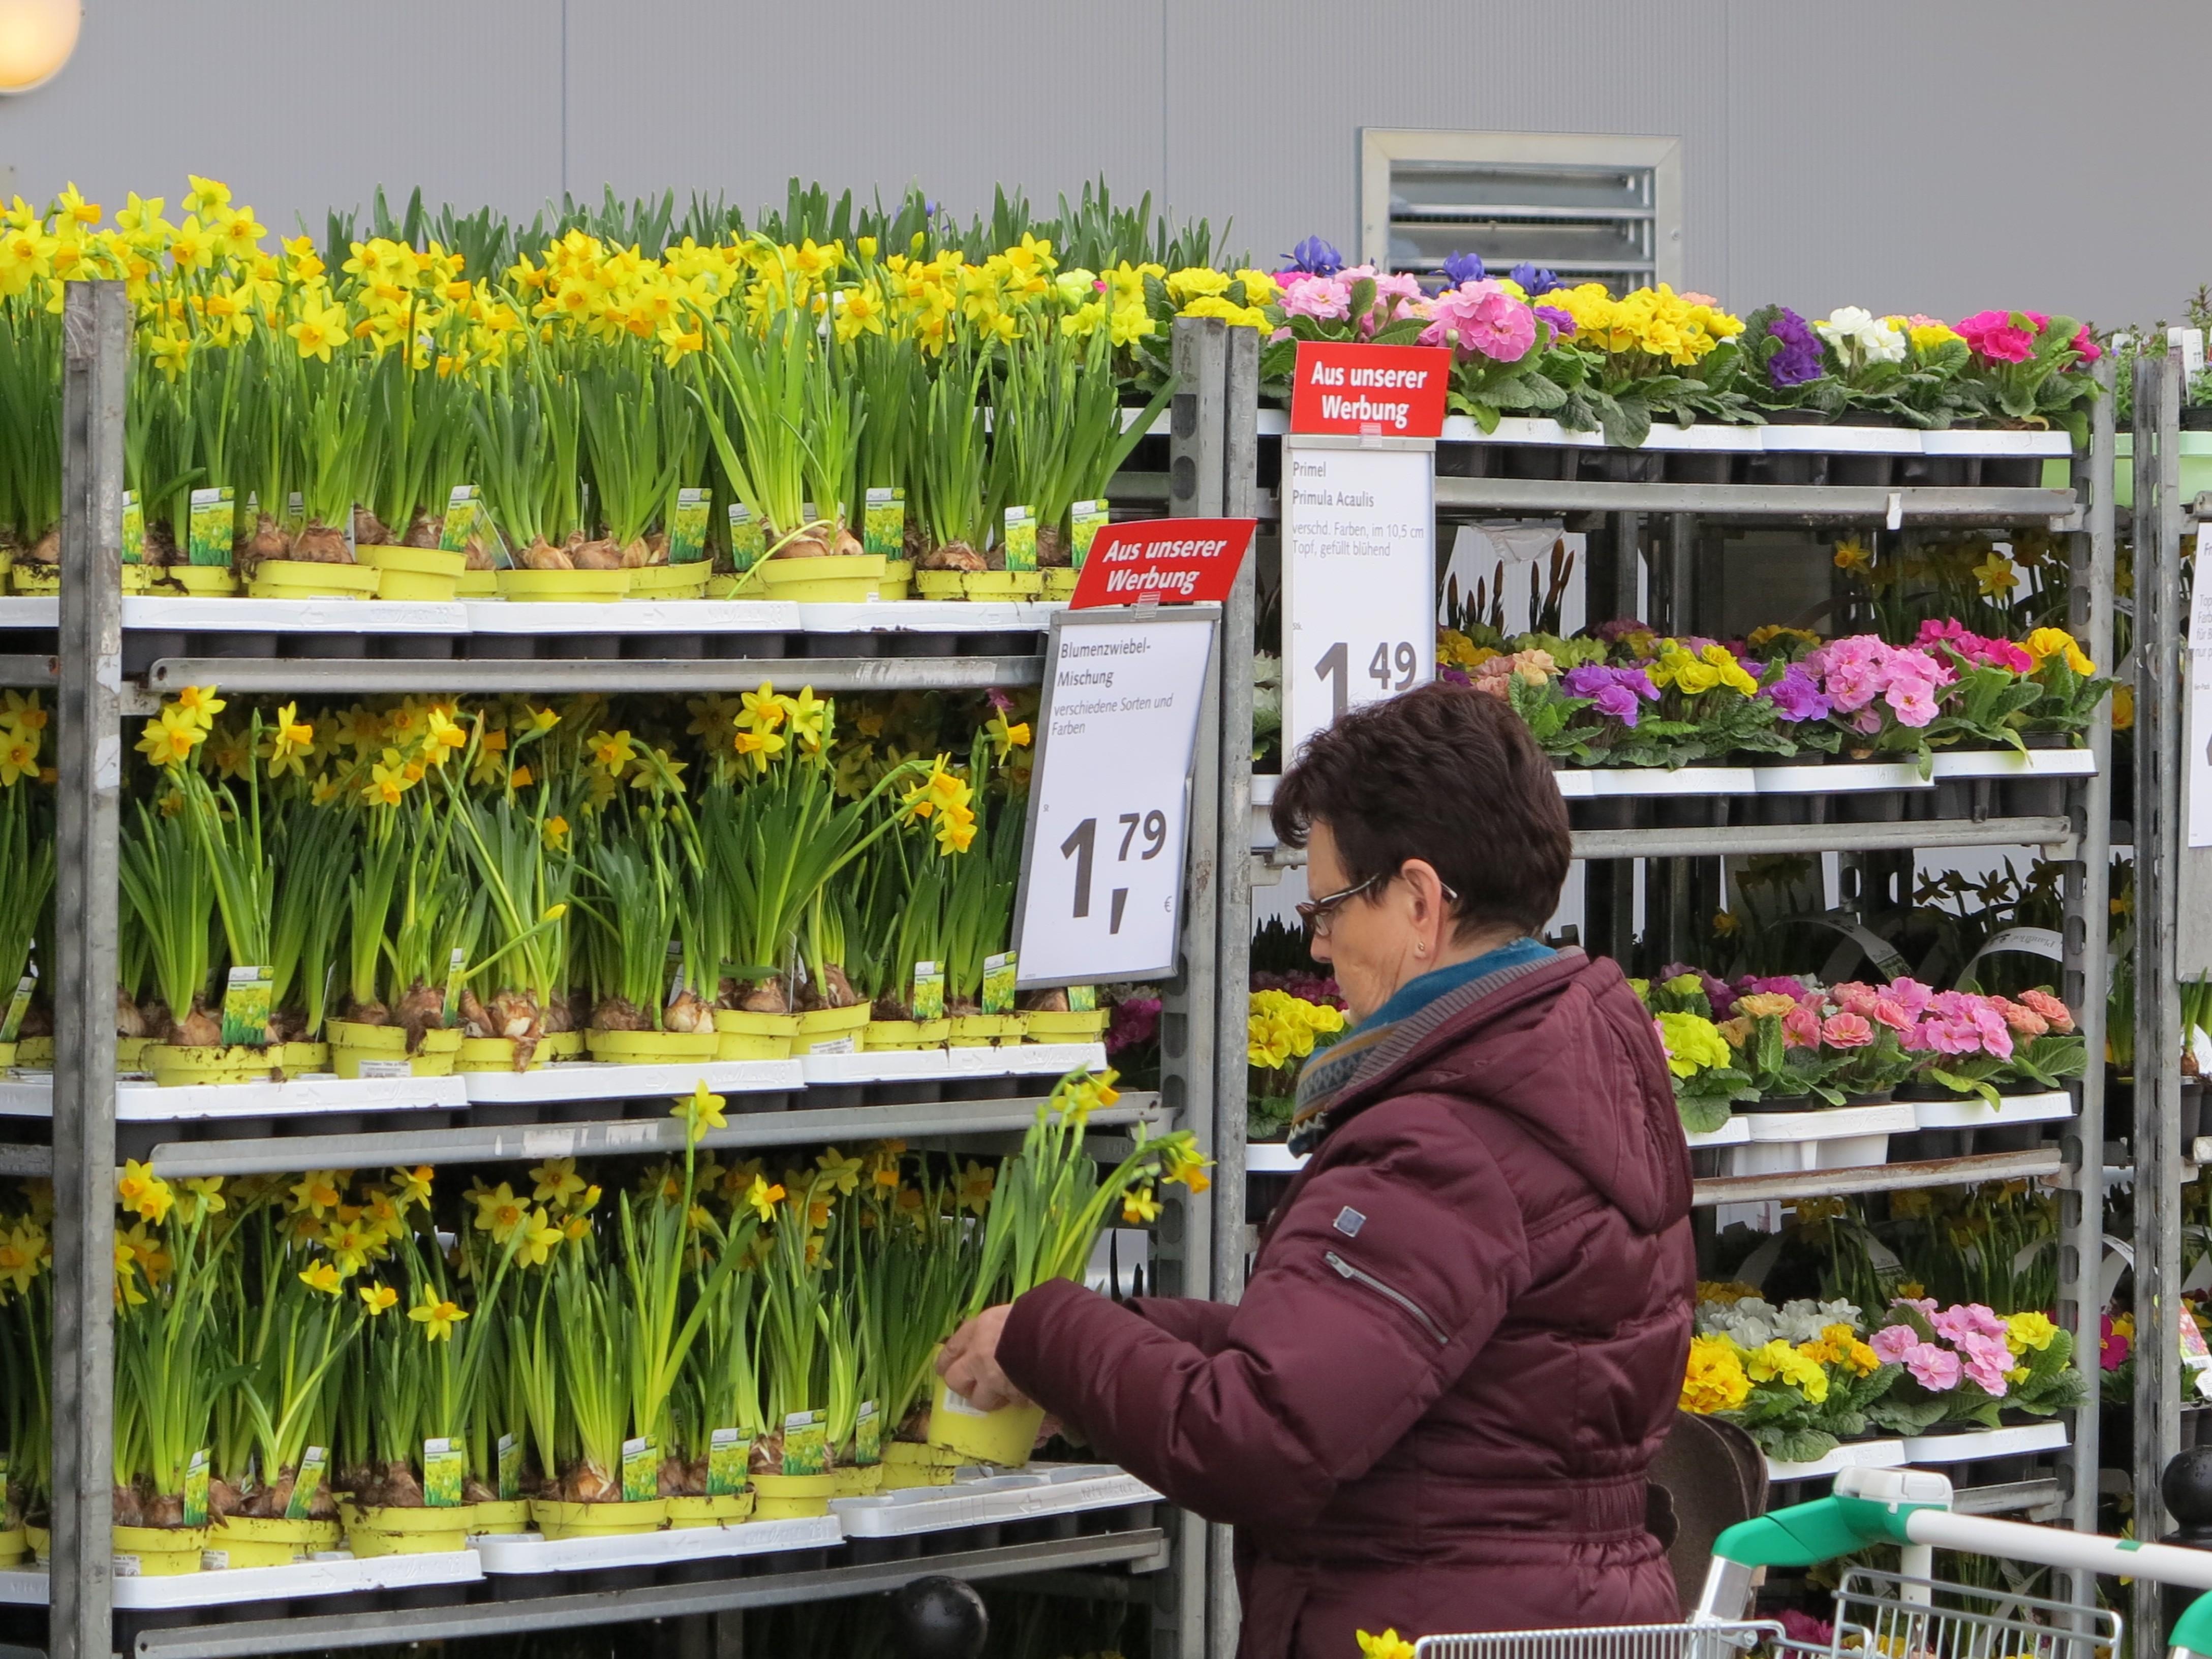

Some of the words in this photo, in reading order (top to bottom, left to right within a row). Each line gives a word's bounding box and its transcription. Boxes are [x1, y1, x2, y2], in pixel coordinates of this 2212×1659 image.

[1310, 360, 1344, 386] Aus
[1350, 368, 1428, 389] unserer
[1322, 394, 1409, 429] Werbung
[1293, 461, 1326, 477] Primel
[1293, 489, 1333, 506] Primula
[1336, 491, 1374, 507] Acaulis
[1293, 520, 1331, 536] verschd.
[1334, 521, 1369, 539] Farben,
[1372, 523, 1383, 537] im
[1387, 524, 1407, 540] 10,5
[1410, 527, 1424, 539] cm
[1102, 540, 1142, 563] Aus
[1145, 540, 1227, 559] unserer
[1293, 540, 1317, 559] Topf,
[1320, 540, 1350, 559] gefüllt
[1353, 541, 1391, 557] blühend
[1106, 565, 1200, 595] Werbung
[1061, 637, 1151, 659] Blumenzwiebel-
[1369, 641, 1417, 691] 49
[1057, 668, 1114, 688] Mischung
[1054, 699, 1118, 717] verschiedene
[1120, 697, 1151, 712] Sorten
[1154, 693, 1174, 709] und
[1052, 720, 1086, 736] Farben
[1118, 809, 1166, 862] 79
